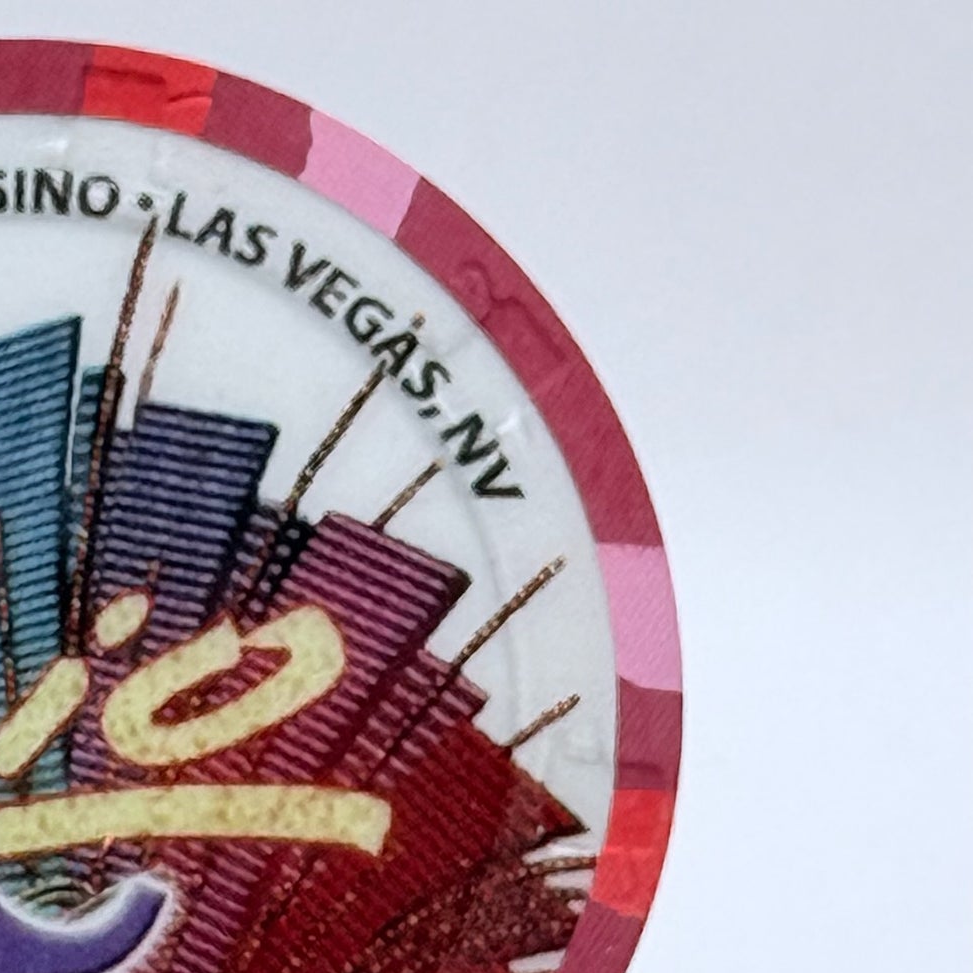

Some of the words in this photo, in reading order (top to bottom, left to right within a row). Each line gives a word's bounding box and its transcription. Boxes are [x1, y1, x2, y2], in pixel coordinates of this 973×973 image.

[163, 190, 278, 267] LAS
[284, 239, 452, 419] VEGAS,
[439, 413, 525, 499] NV
